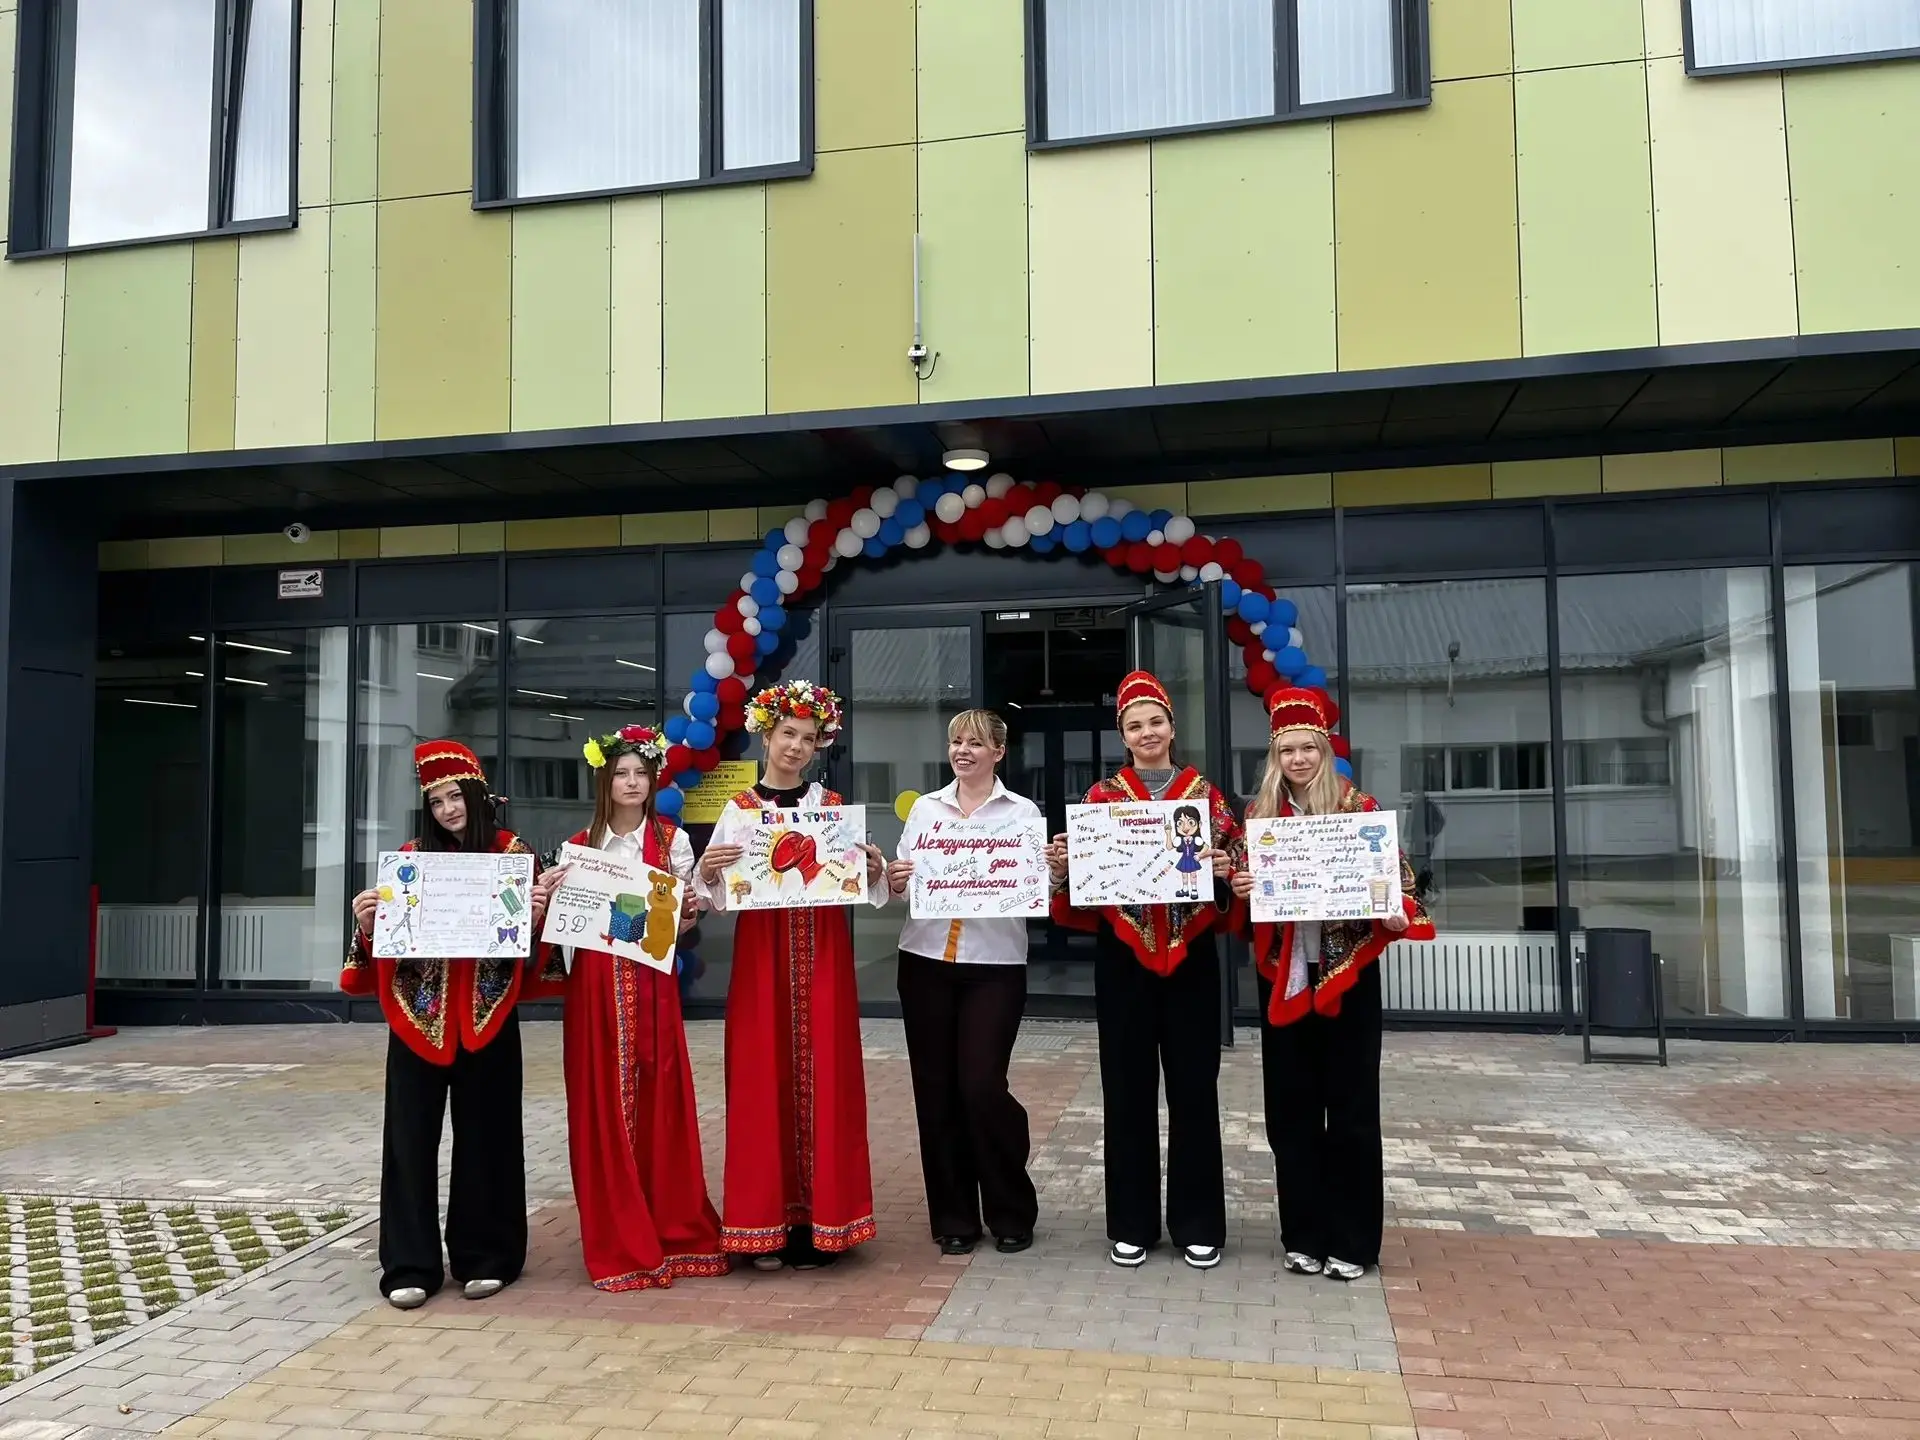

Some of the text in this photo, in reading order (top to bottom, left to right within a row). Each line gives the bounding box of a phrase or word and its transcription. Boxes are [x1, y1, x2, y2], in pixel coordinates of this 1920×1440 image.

[792, 811, 801, 823] В
[911, 832, 1023, 855] Международный
[988, 858, 1019, 874] день
[926, 879, 1018, 897] грамотности
